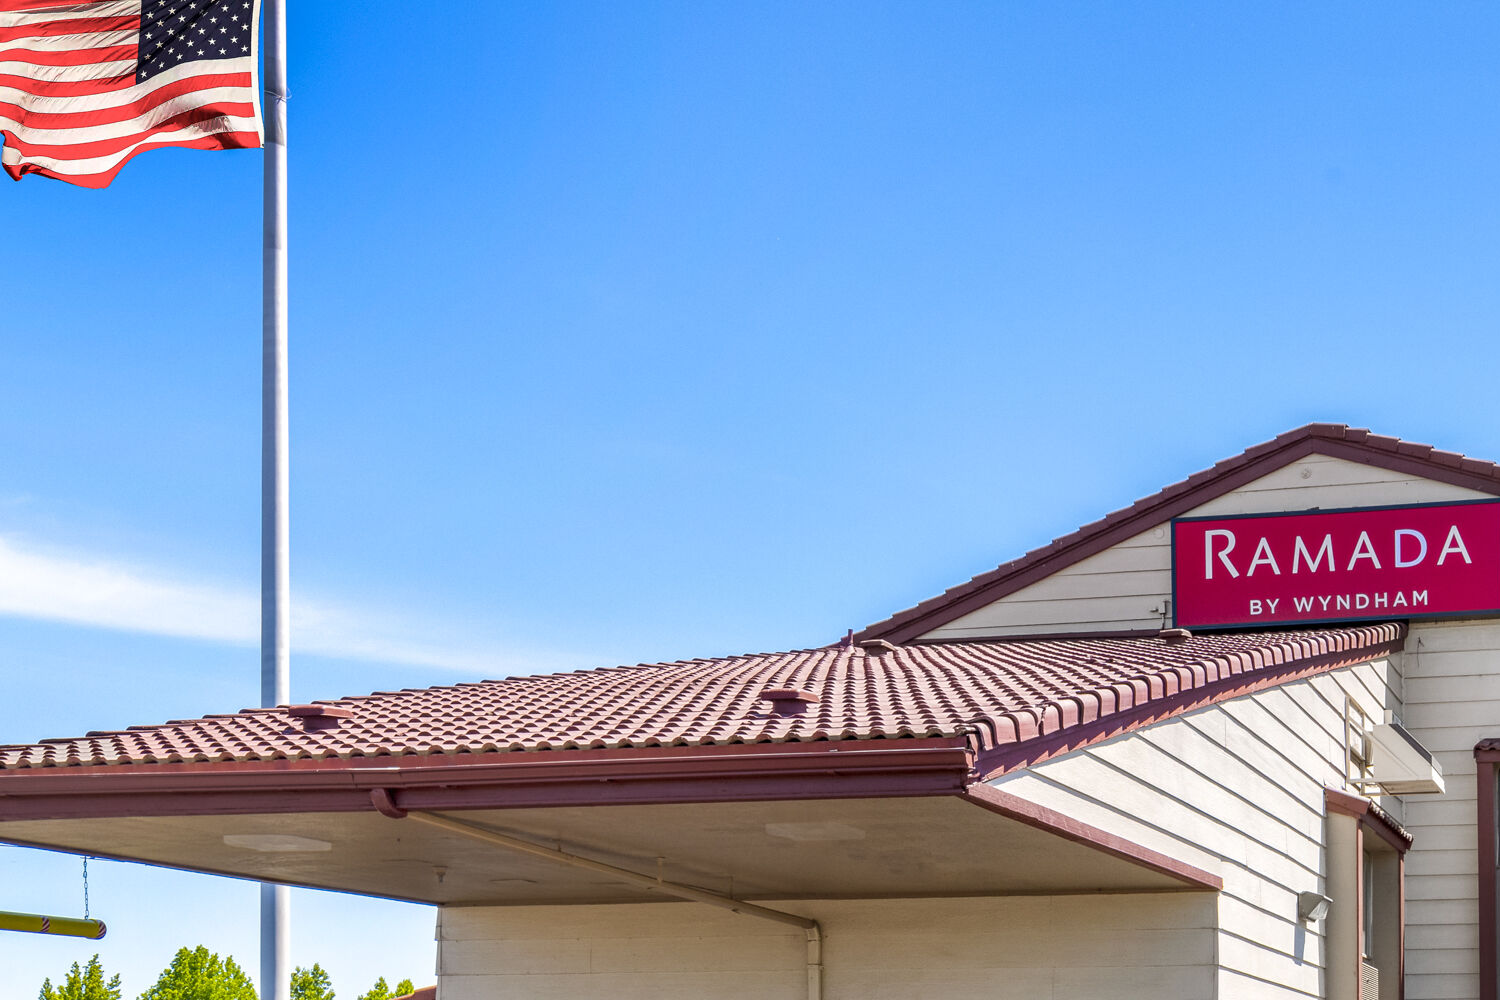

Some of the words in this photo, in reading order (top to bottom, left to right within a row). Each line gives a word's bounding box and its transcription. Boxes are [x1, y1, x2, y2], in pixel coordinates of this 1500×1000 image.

[1204, 524, 1473, 580] RAMADA
[1249, 599, 1280, 616] BY
[1293, 589, 1428, 613] WYNDHAM
